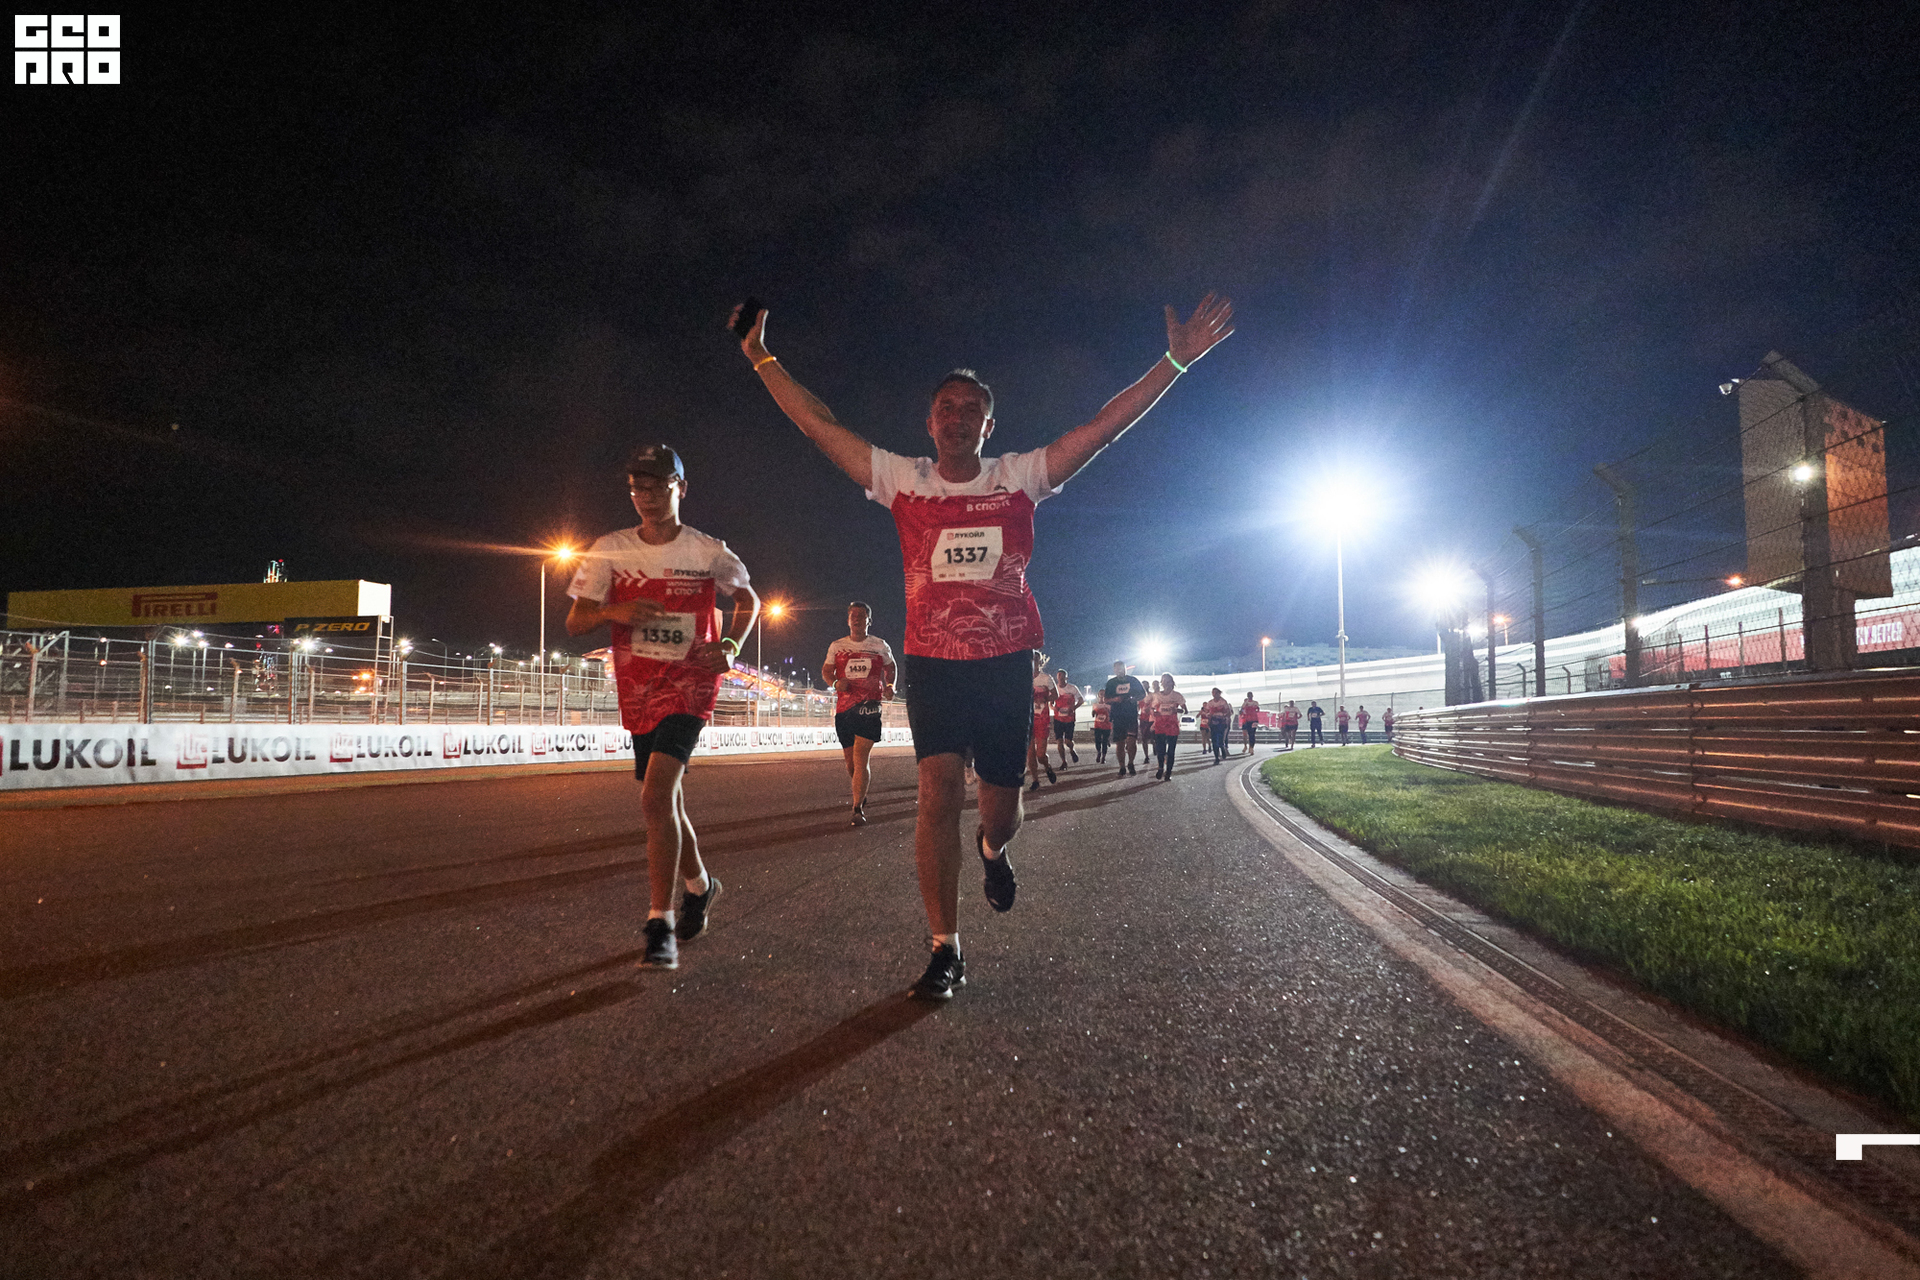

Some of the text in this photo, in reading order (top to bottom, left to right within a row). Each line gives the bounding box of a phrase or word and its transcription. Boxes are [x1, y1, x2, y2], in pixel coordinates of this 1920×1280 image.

[944, 546, 988, 564] 1337
[132, 592, 218, 618] PIRELLI
[295, 622, 370, 632] P ZERO
[642, 628, 683, 645] 1338
[9, 737, 157, 771] LUKOIL
[212, 736, 316, 764] LUKOIL
[356, 734, 433, 759] LUKOIL
[463, 733, 525, 755] LUKOIL
[548, 733, 598, 752] LUKOIL
